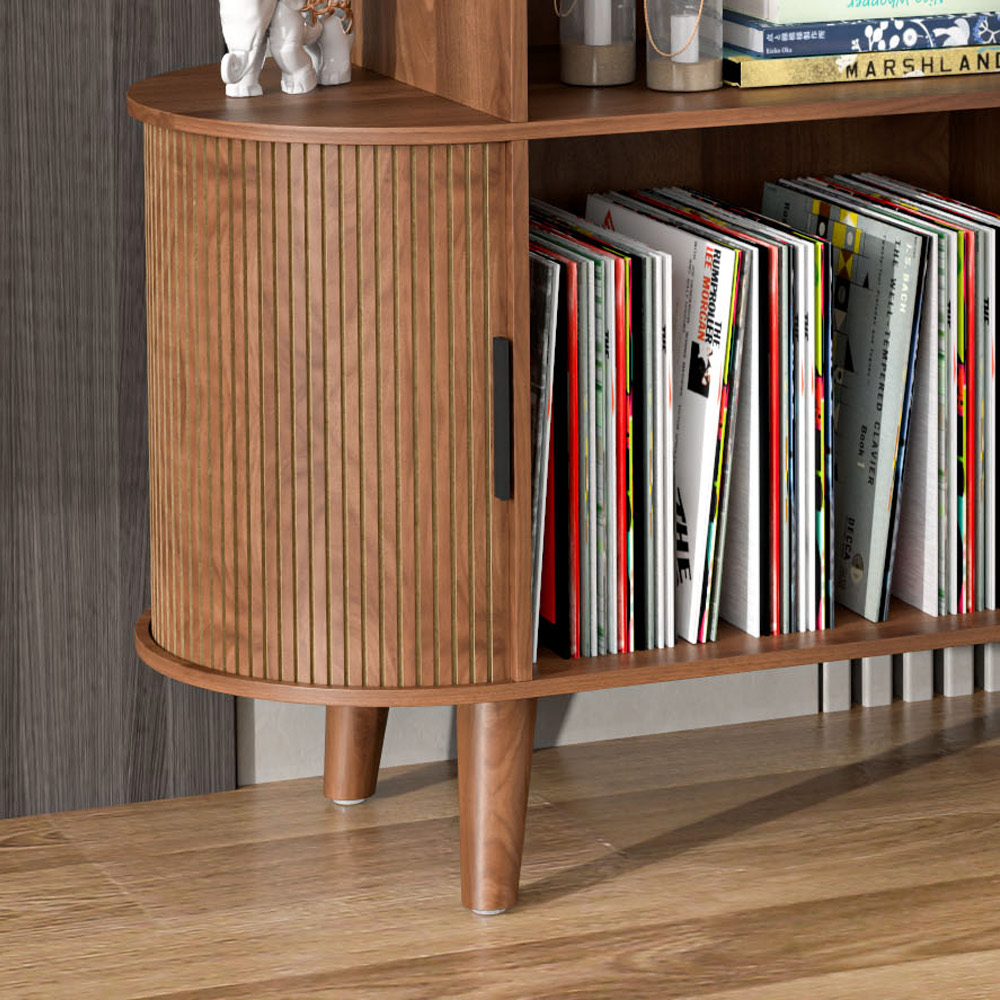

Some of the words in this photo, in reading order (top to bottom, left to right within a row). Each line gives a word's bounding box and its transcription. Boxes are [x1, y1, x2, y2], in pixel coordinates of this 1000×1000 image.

[892, 240, 901, 266] THE
[697, 275, 711, 342] MORGAN
[899, 273, 910, 314] BACH
[712, 321, 723, 349] THE
[858, 424, 868, 457] Book
[867, 421, 881, 486] CLAVIER
[843, 516, 856, 561] DECCA
